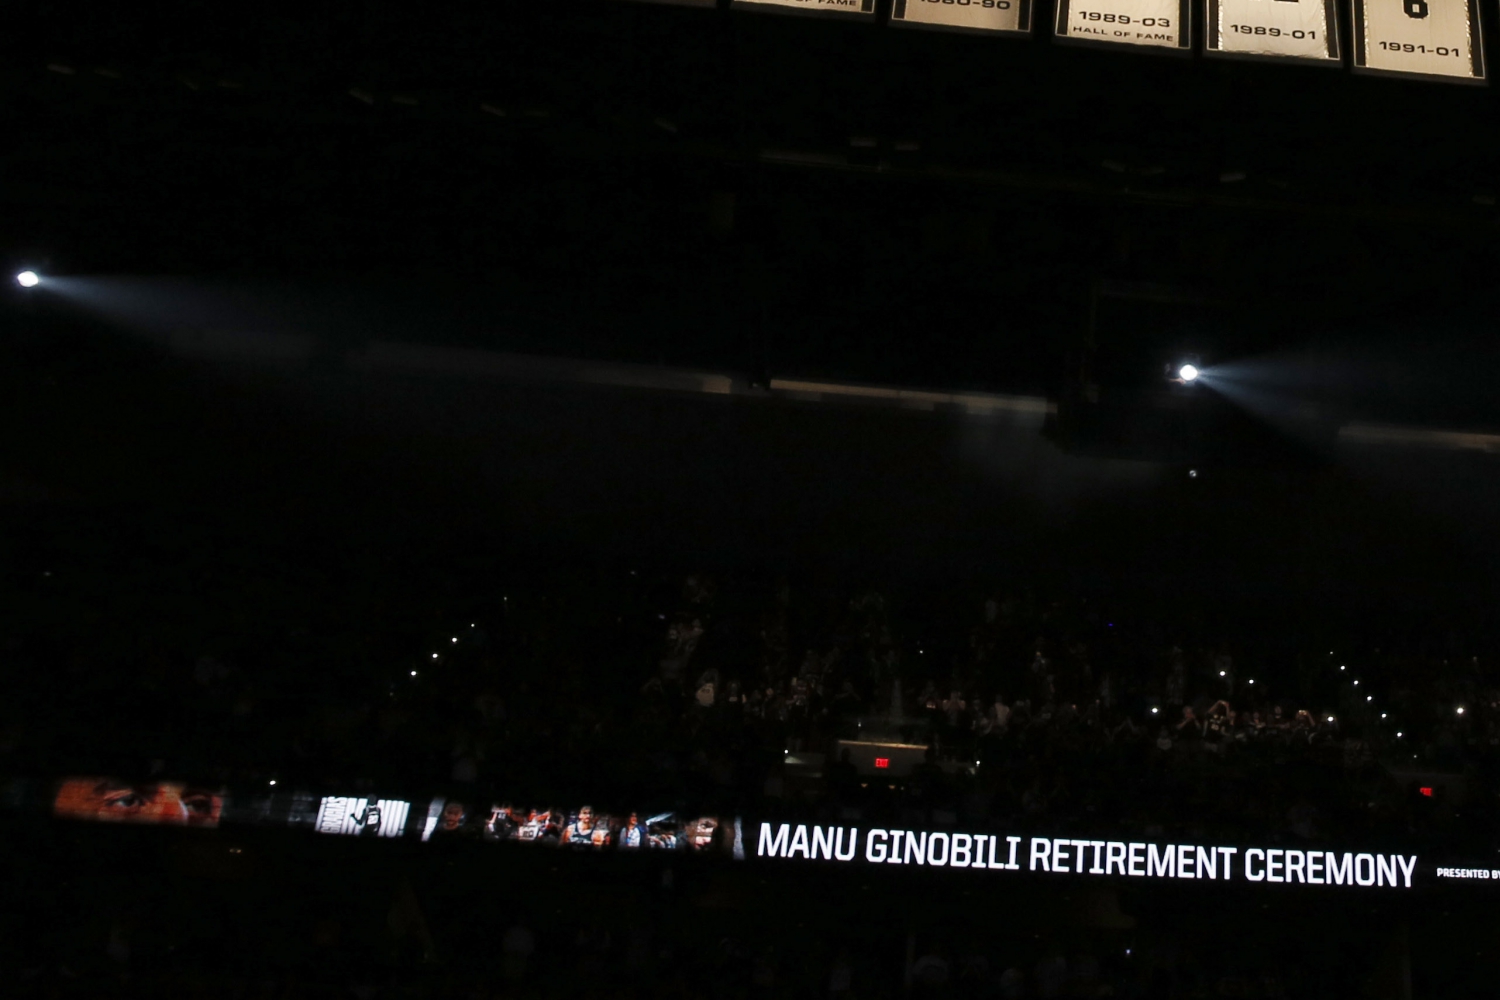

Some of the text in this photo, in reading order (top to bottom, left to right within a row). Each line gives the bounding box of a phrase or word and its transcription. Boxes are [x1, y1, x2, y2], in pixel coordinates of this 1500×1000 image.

[1078, 10, 1171, 28] 1989-03
[1073, 25, 1174, 42] HALL OF FAME
[1230, 24, 1316, 40] 1989-01
[1379, 41, 1460, 57] 1991-01
[757, 822, 1417, 888] MANU GINOBILI RETIREMENT CEREMONY
[1436, 867, 1491, 879] PRESENTED
